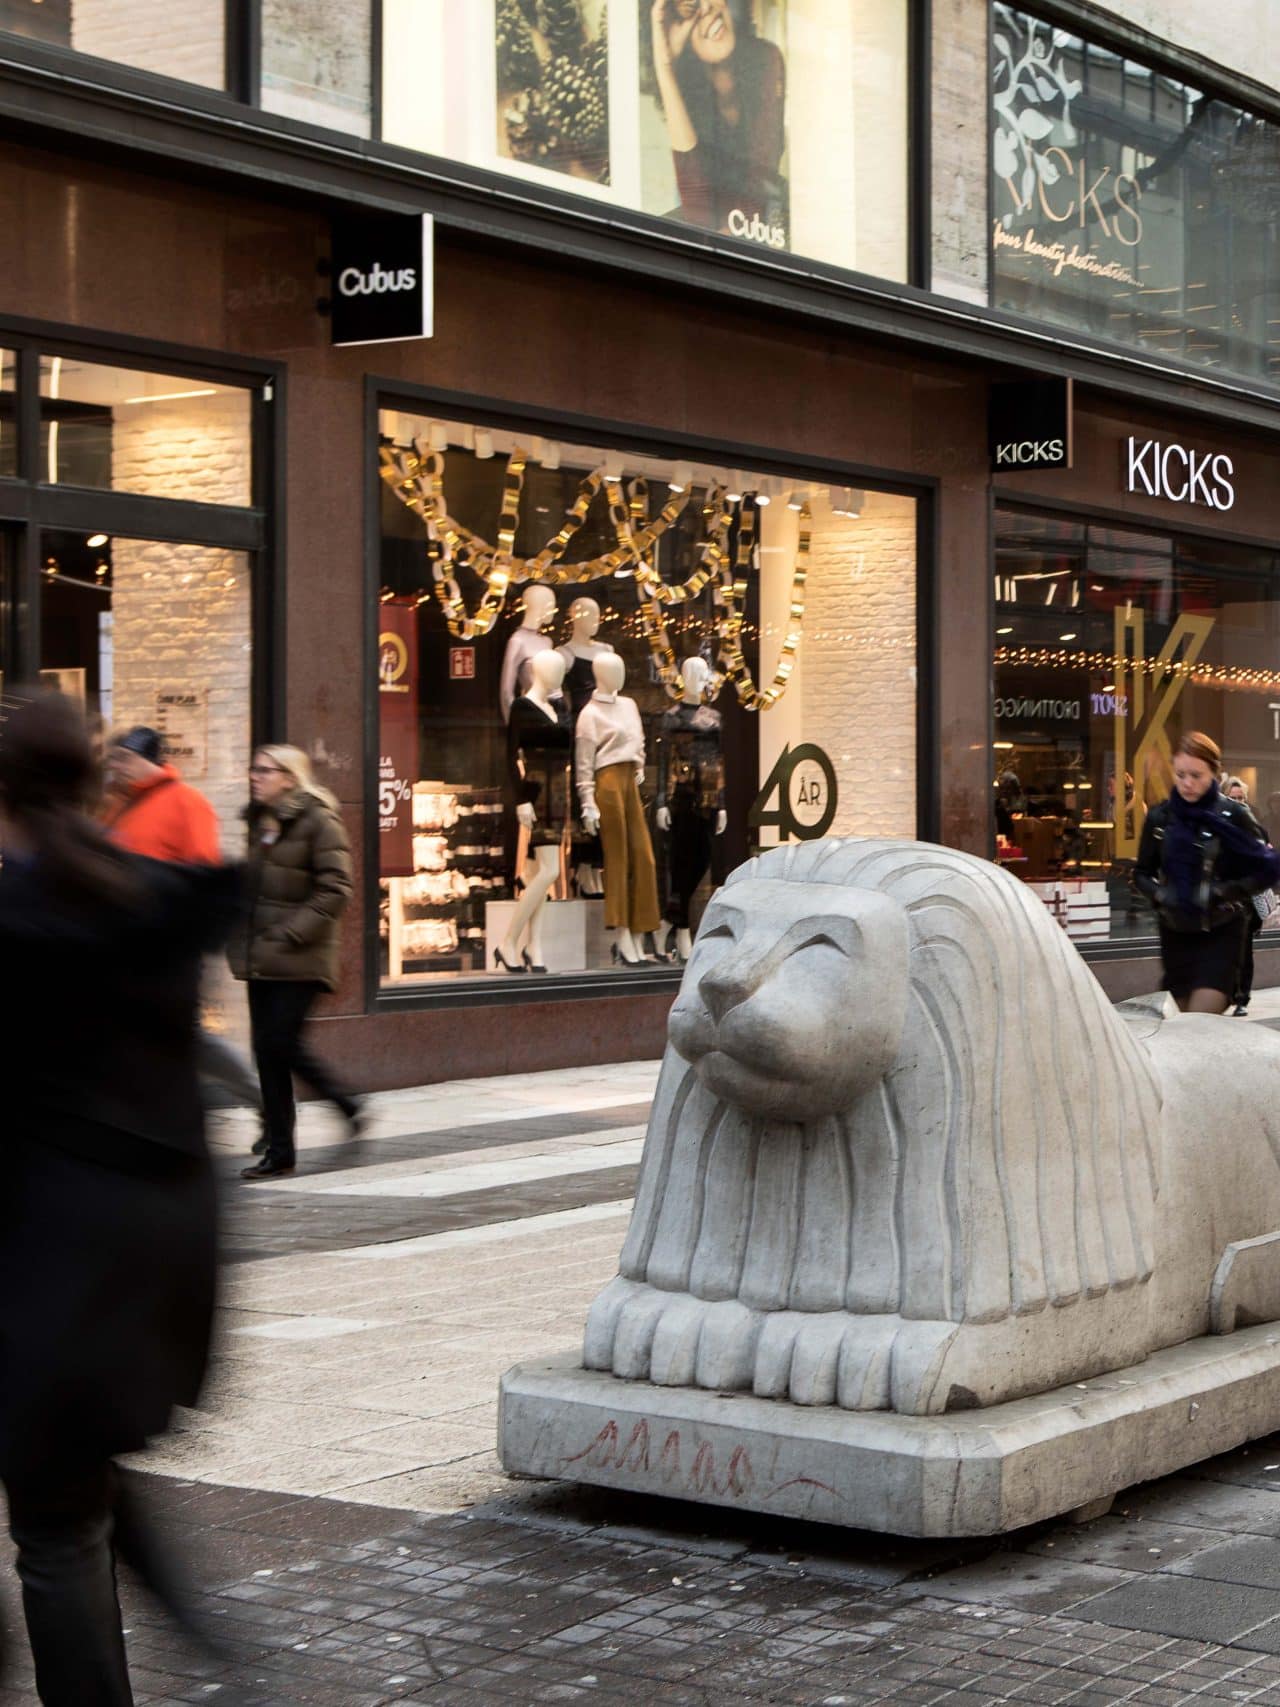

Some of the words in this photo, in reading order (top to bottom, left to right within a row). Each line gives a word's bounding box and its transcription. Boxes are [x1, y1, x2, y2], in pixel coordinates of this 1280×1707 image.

[728, 210, 785, 247] Cubus
[339, 262, 416, 296] Cubus
[996, 439, 1064, 464] KICKS
[1128, 436, 1235, 511] KICKS
[797, 777, 820, 806] ÅR
